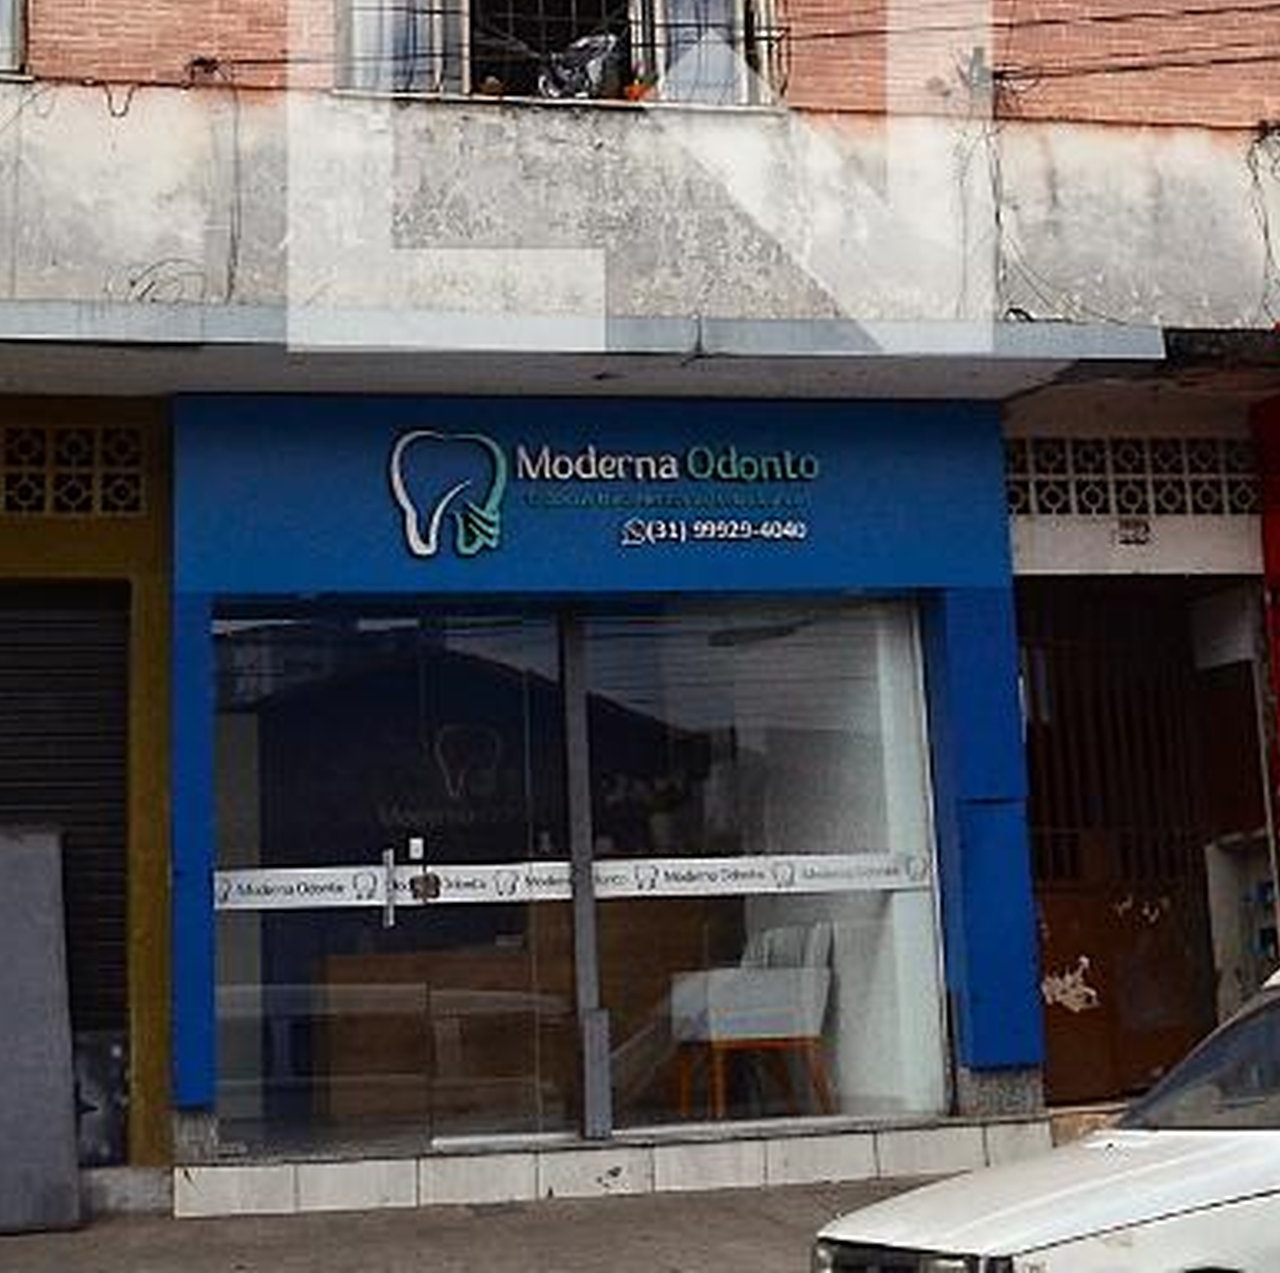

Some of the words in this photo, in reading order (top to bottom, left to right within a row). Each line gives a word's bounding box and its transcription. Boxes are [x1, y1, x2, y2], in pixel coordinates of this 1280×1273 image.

[516, 444, 679, 479] Moderna
[686, 445, 820, 479] Odonto
[645, 519, 687, 543] (31)
